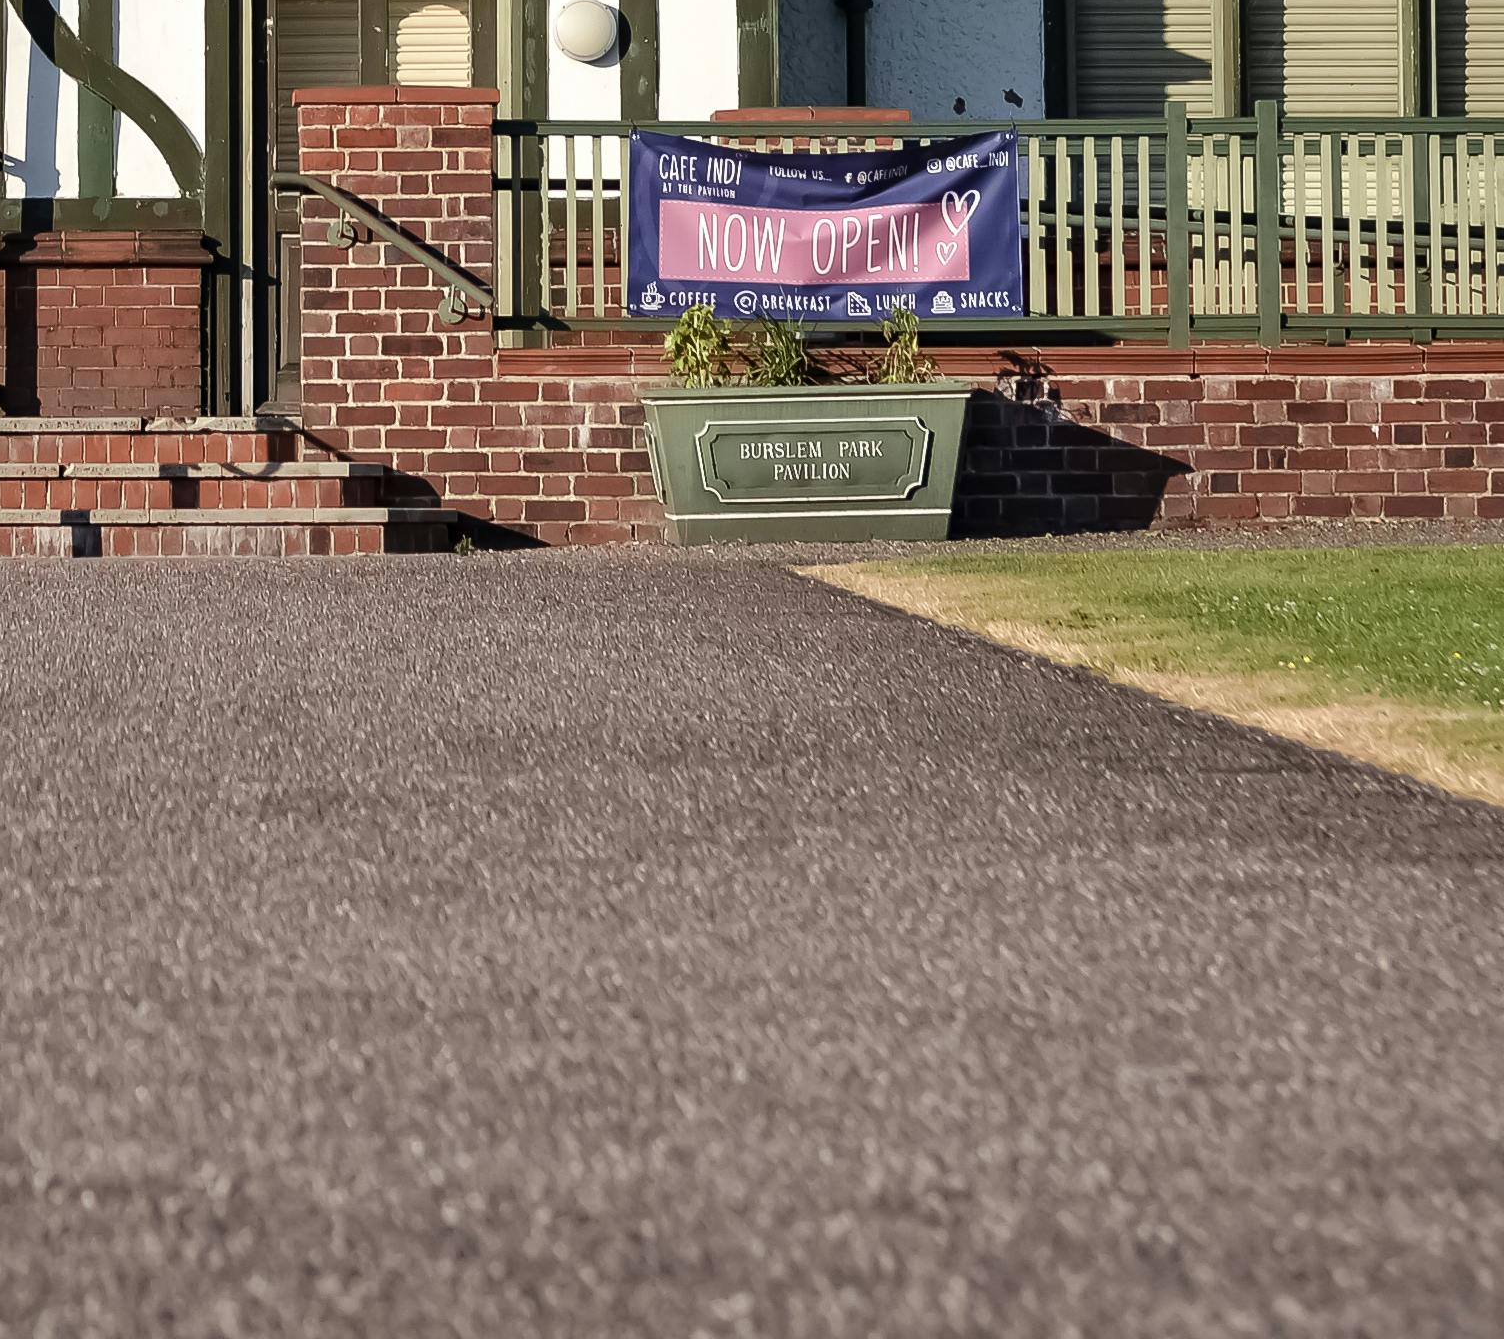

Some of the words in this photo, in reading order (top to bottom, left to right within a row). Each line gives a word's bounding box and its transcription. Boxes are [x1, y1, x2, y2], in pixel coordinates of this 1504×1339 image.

[659, 154, 698, 182] CAFE
[706, 157, 742, 186] INDI
[769, 165, 807, 180] FOLLOW
[662, 183, 672, 194] AT
[678, 184, 693, 195] THE
[697, 185, 736, 199] PAVILION
[698, 211, 786, 275] NOW
[811, 211, 920, 275] OPEN!
[669, 291, 717, 306] COFFEE
[762, 294, 831, 312] BREAKFAST
[875, 293, 916, 311] LUNCH
[960, 291, 1010, 309] SNACKS
[740, 441, 822, 459] BURSLEM
[839, 439, 883, 458] PARK
[773, 463, 851, 481] PAVILION
